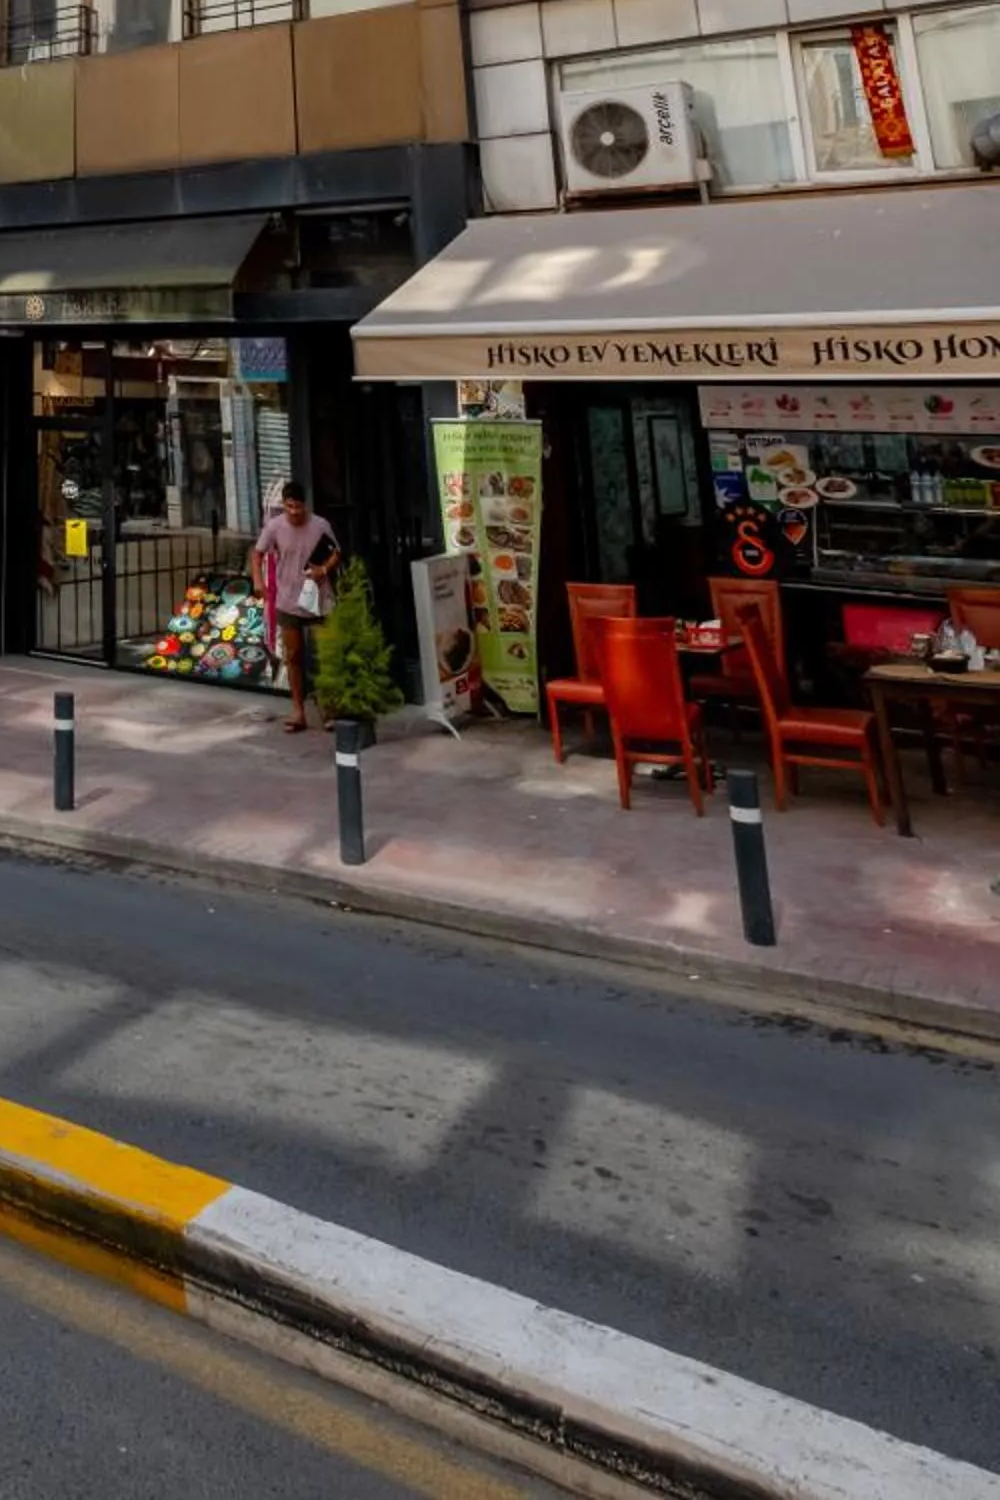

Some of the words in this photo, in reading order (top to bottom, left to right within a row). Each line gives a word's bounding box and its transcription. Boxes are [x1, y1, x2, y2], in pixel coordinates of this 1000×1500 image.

[652, 91, 675, 145] arçelik
[577, 341, 607, 363] EV
[813, 335, 923, 366] HİSKO
